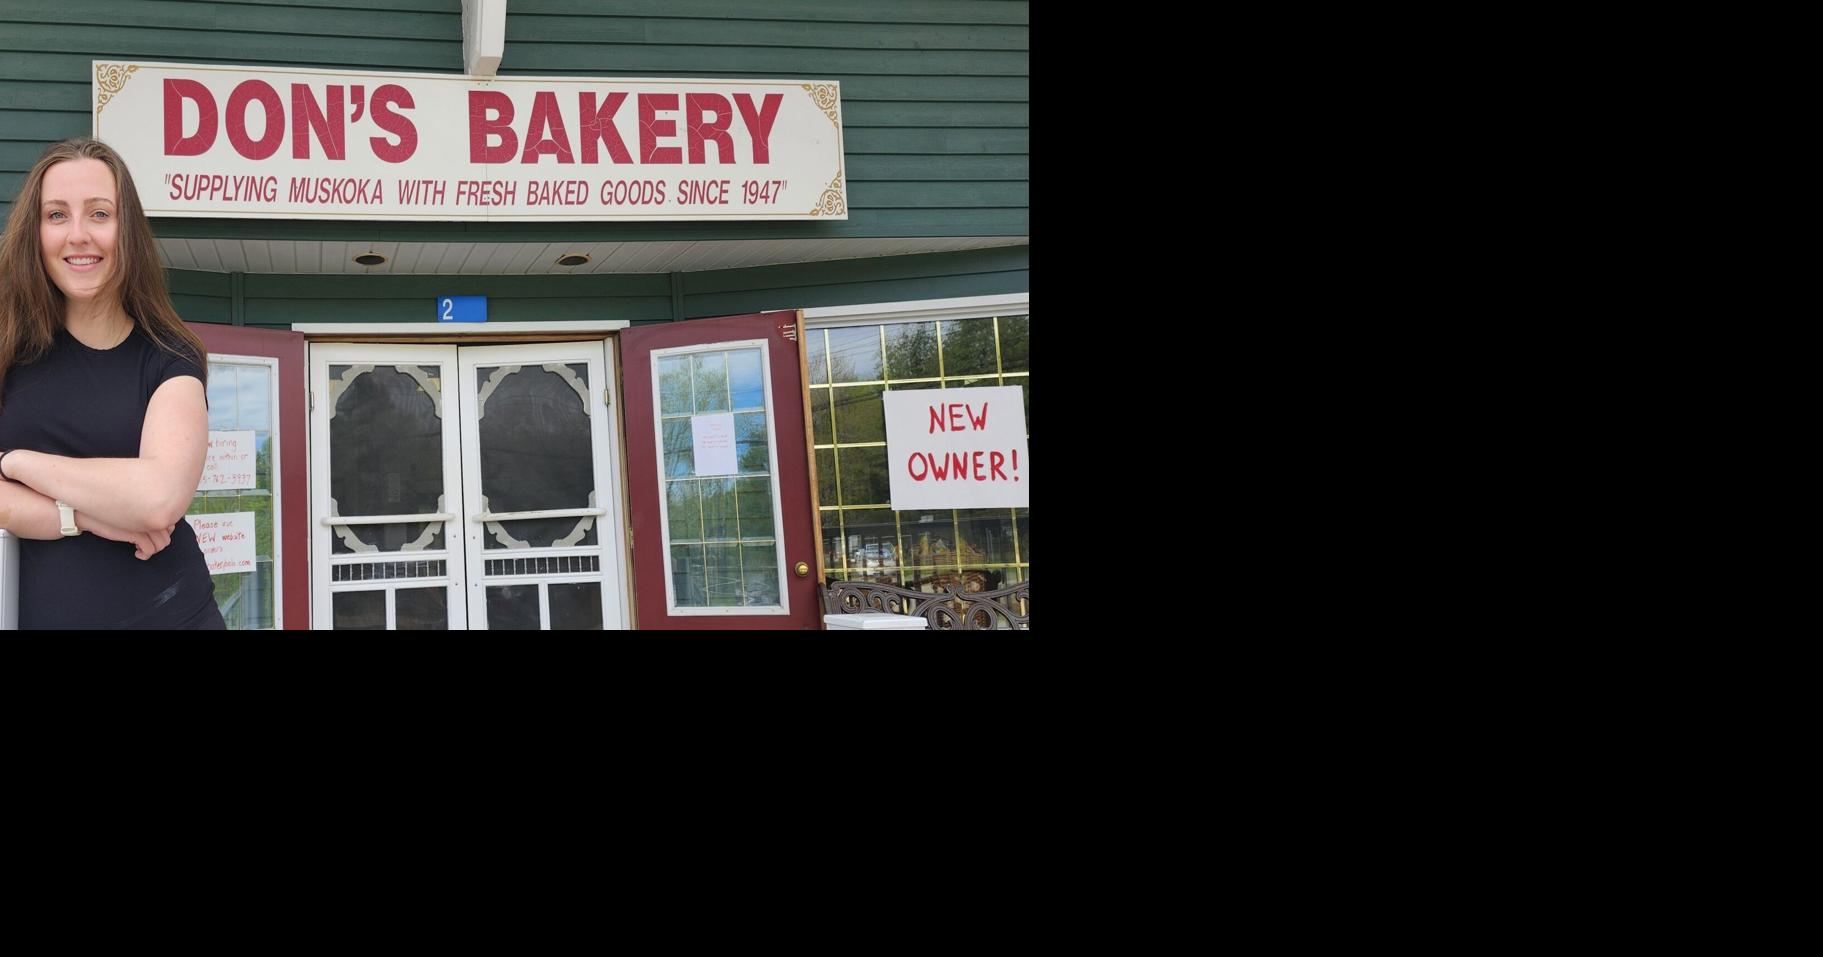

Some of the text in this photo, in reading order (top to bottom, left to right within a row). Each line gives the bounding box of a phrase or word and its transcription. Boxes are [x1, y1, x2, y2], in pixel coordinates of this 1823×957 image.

[163, 78, 784, 165] DON'S BAKERY
[164, 173, 787, 206] "SUPPLYING MUSKOKA WITH FRESH BAKED GOODS SINCE 1947"
[442, 298, 453, 320] 2
[928, 402, 988, 433] NEW
[907, 448, 1019, 481] OWNER!
